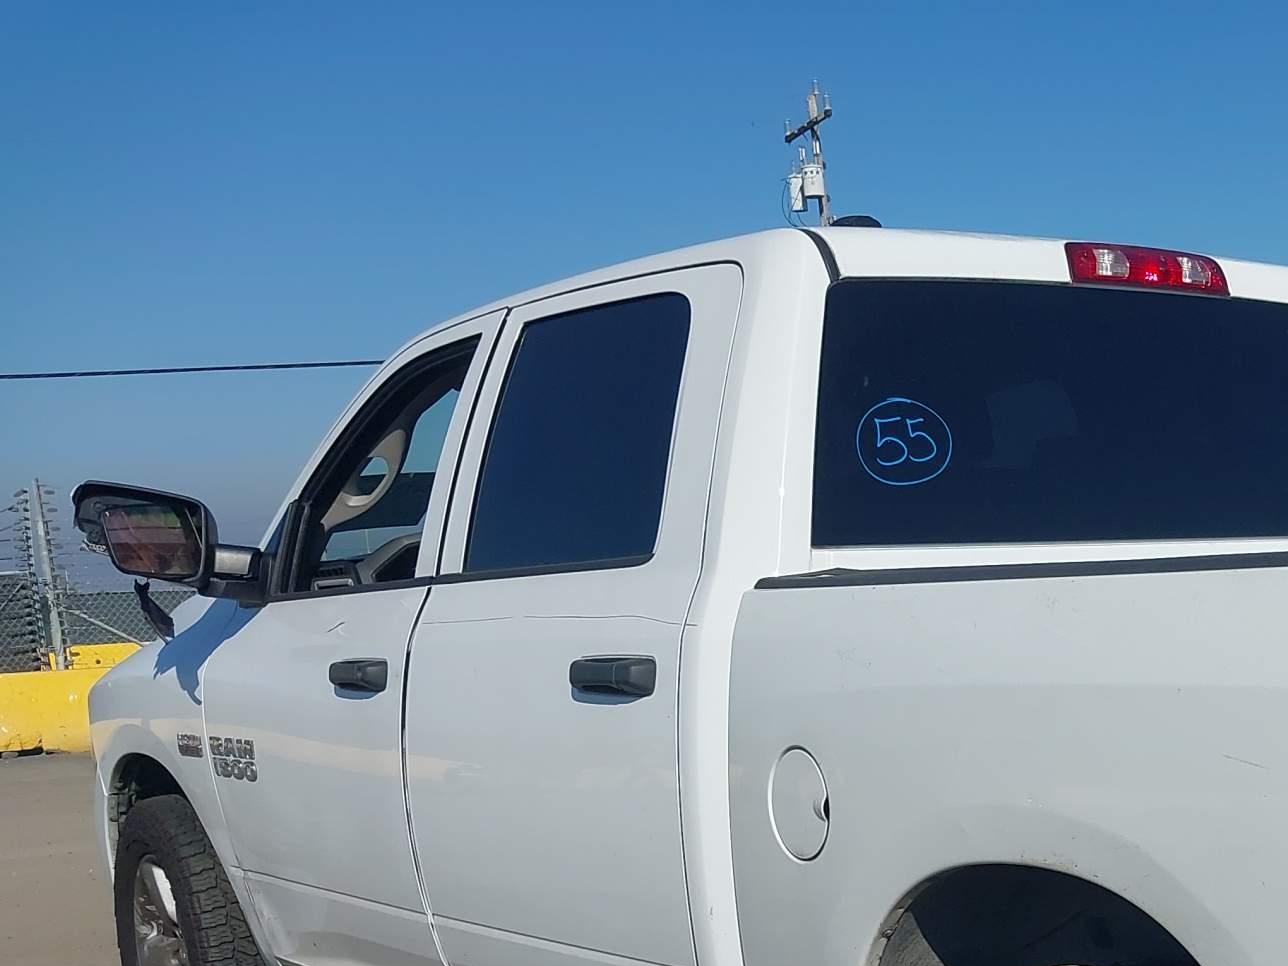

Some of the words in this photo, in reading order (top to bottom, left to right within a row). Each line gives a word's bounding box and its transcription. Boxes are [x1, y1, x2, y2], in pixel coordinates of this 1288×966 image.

[873, 416, 938, 467] 55
[208, 735, 256, 761] RAM
[212, 756, 258, 783] 1500
